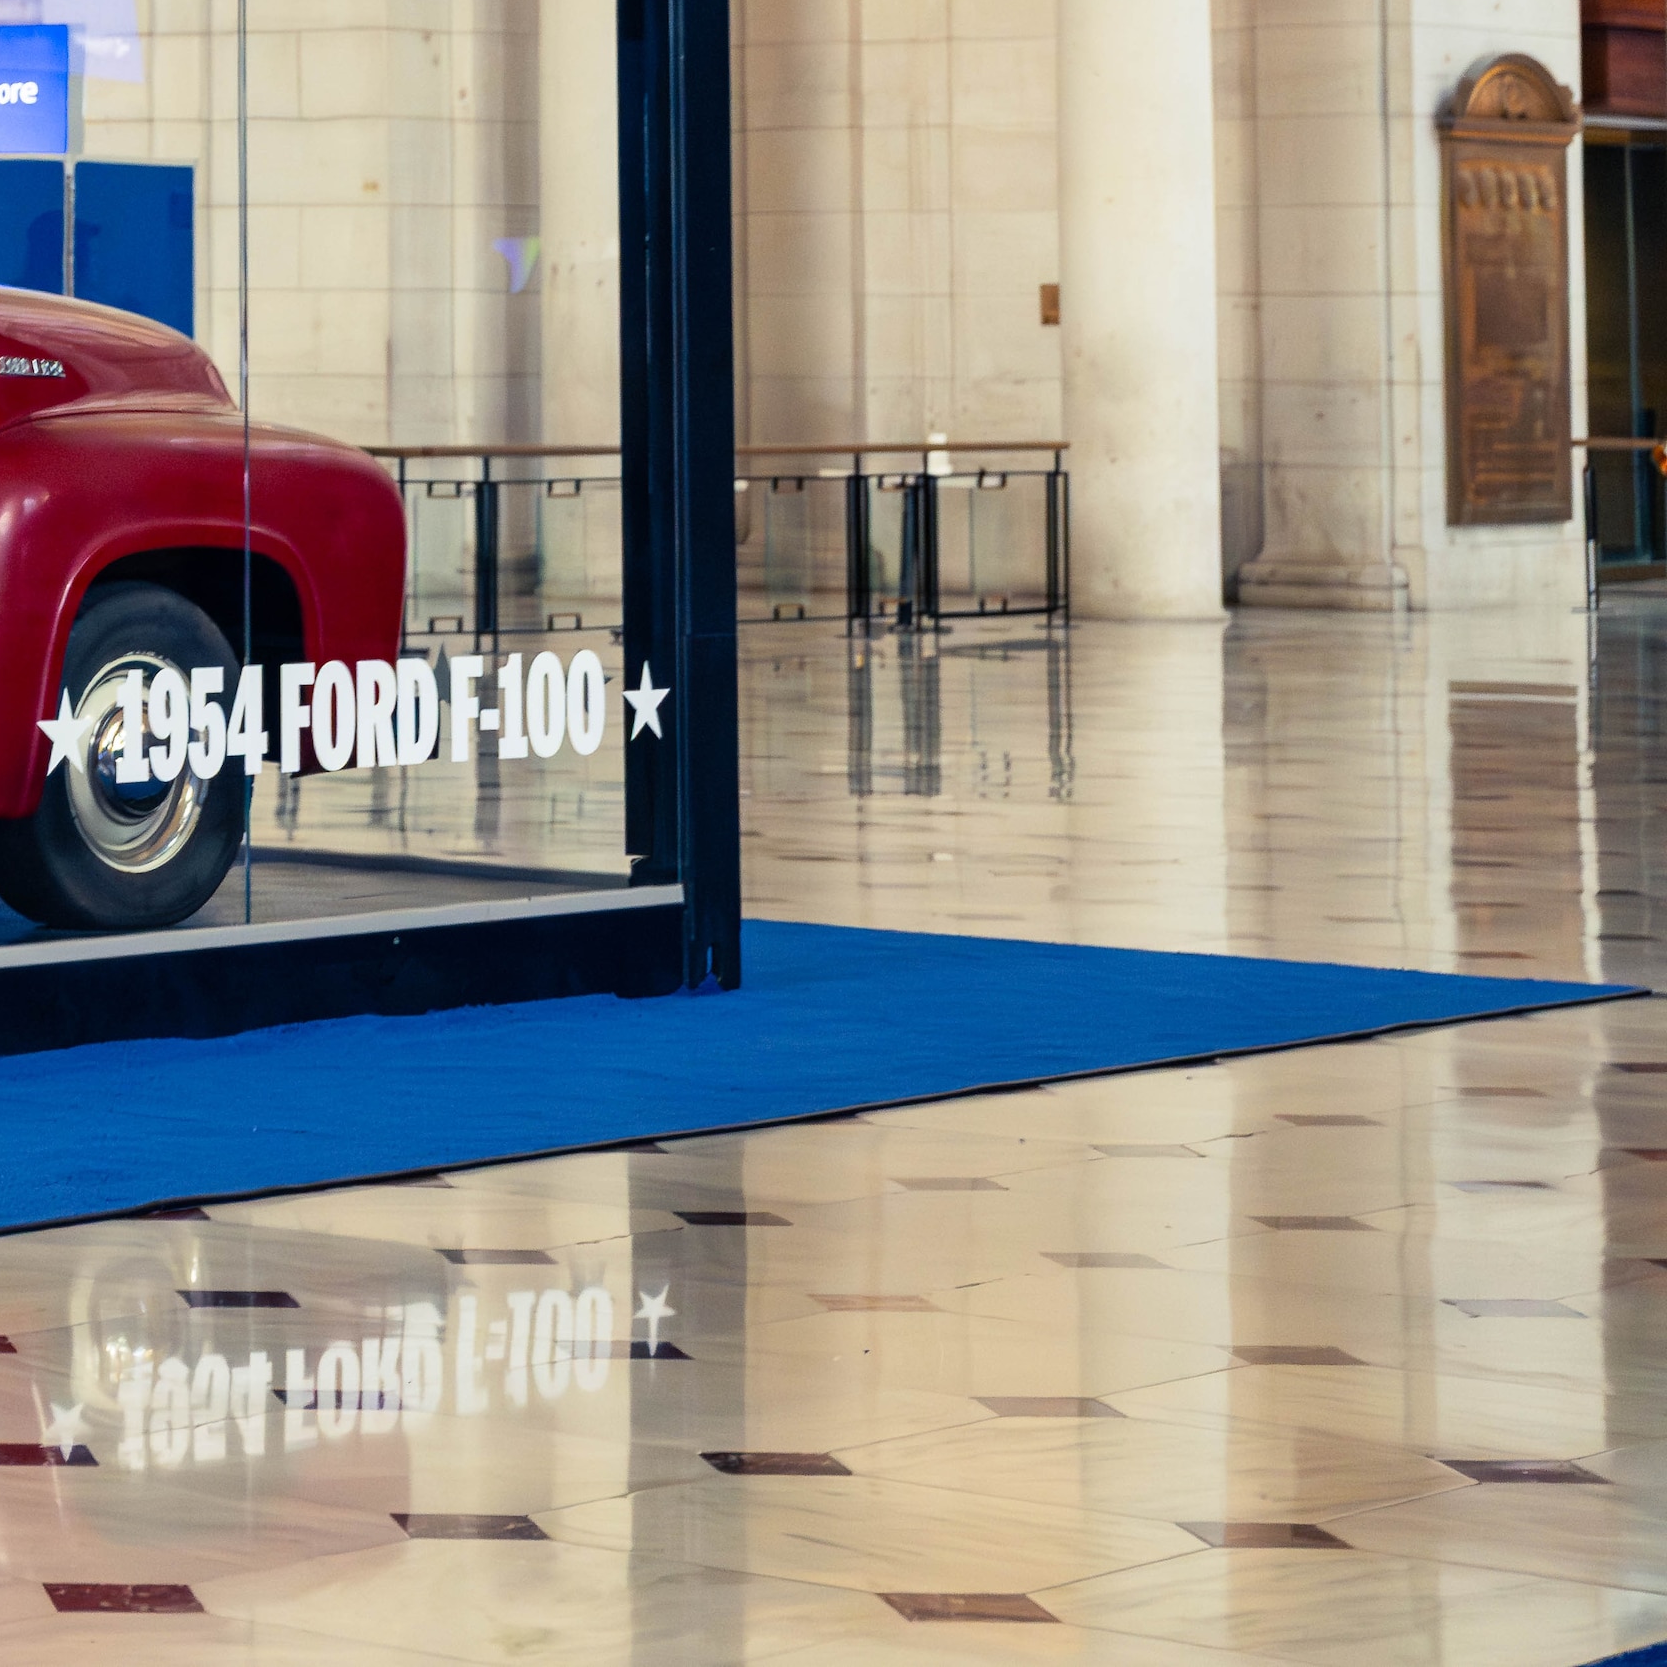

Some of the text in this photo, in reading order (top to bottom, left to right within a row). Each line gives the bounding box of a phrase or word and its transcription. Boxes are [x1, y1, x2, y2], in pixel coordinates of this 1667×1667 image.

[115, 648, 606, 785] 1954 FORD F-100
